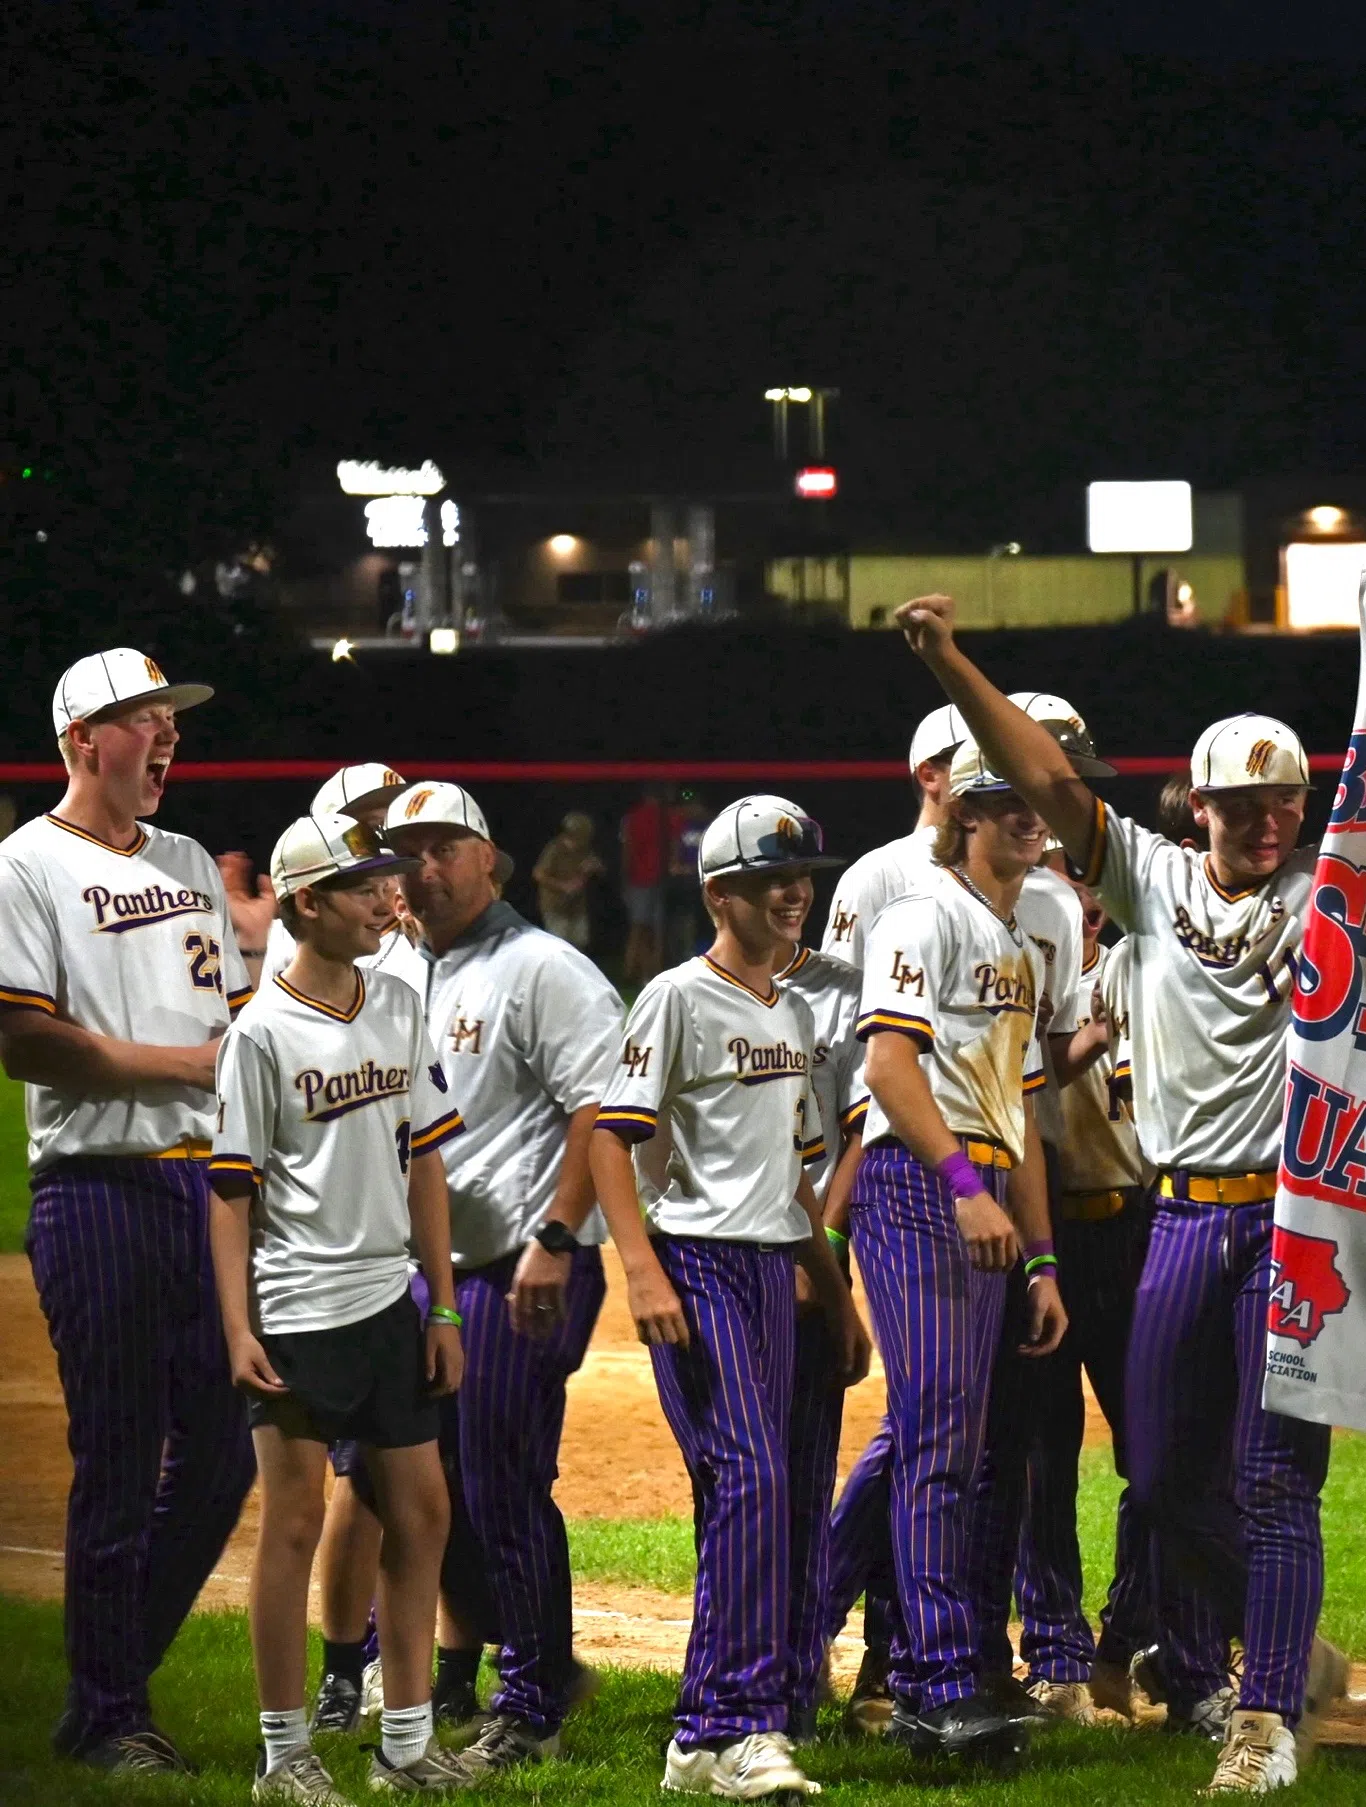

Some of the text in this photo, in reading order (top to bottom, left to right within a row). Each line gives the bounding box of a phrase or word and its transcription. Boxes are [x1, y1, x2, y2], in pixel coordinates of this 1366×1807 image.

[82, 884, 214, 924] Panthers
[832, 900, 858, 942] LM
[890, 950, 925, 998] LM
[295, 1059, 409, 1113] Panther
[1268, 1350, 1305, 1368] SCHOOL
